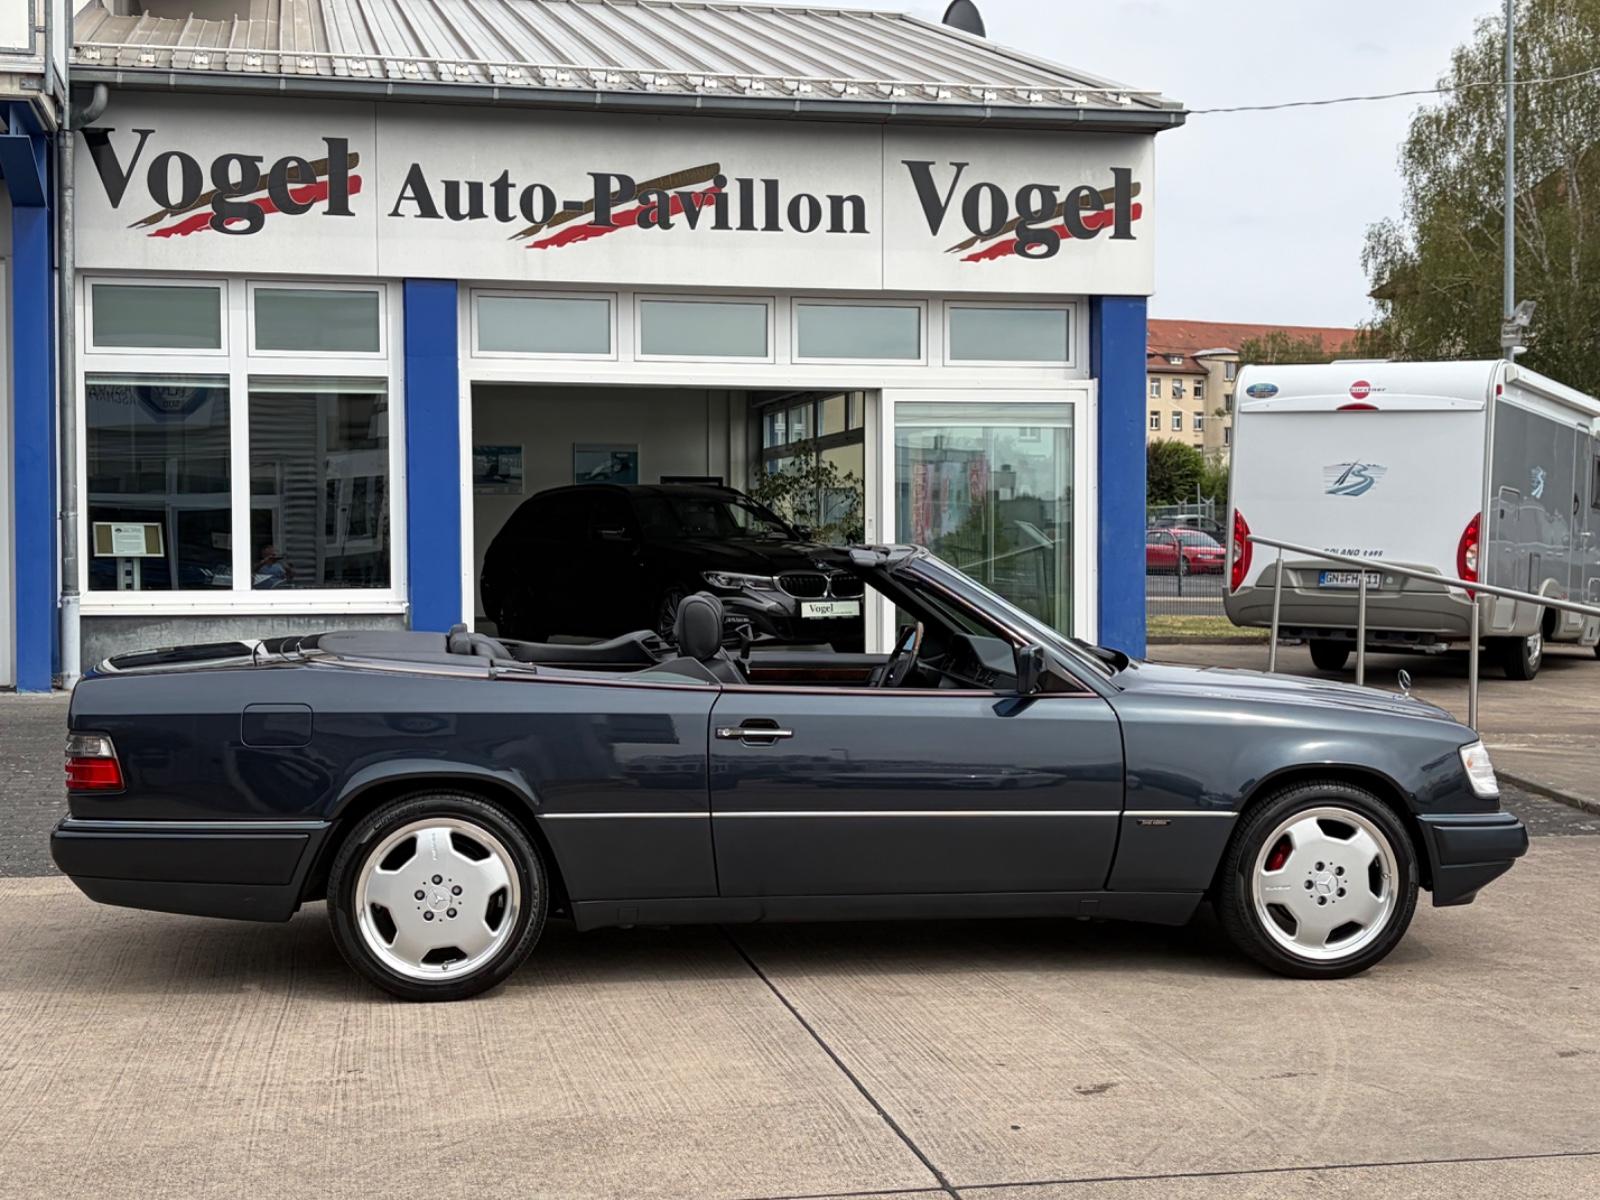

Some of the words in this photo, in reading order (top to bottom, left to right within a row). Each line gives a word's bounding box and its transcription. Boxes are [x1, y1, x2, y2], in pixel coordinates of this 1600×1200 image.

[79, 127, 355, 235] Vogel
[387, 162, 870, 234] Auto-Pavillon
[901, 159, 1136, 260] Vogel
[809, 603, 833, 614] Vogel
